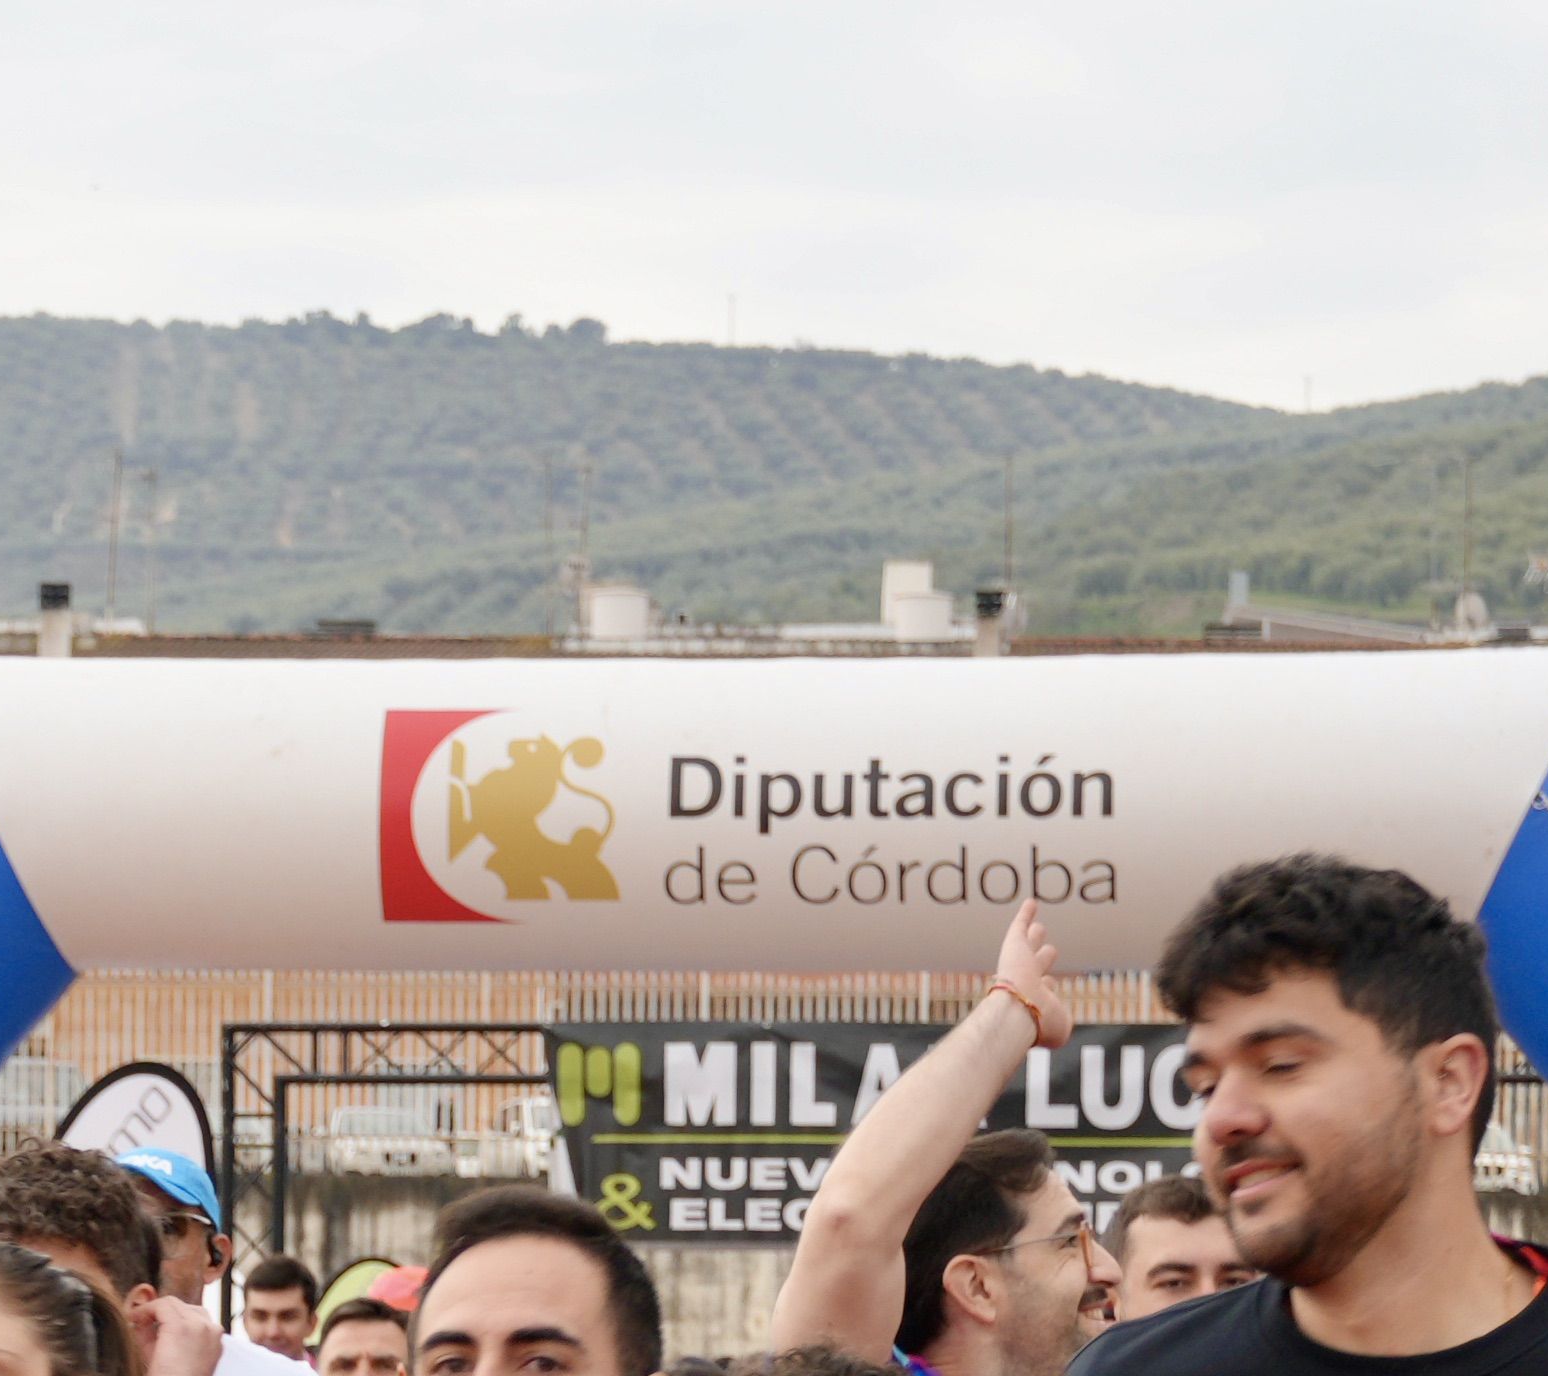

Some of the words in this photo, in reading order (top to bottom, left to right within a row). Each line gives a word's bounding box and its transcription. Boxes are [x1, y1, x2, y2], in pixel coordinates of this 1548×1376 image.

[669, 753, 1114, 835] Diputación
[663, 845, 758, 905] de
[790, 844, 1118, 905] Córdoba
[596, 1173, 655, 1231] &
[659, 1157, 830, 1190] NUEV
[669, 1198, 807, 1232] ELEC
